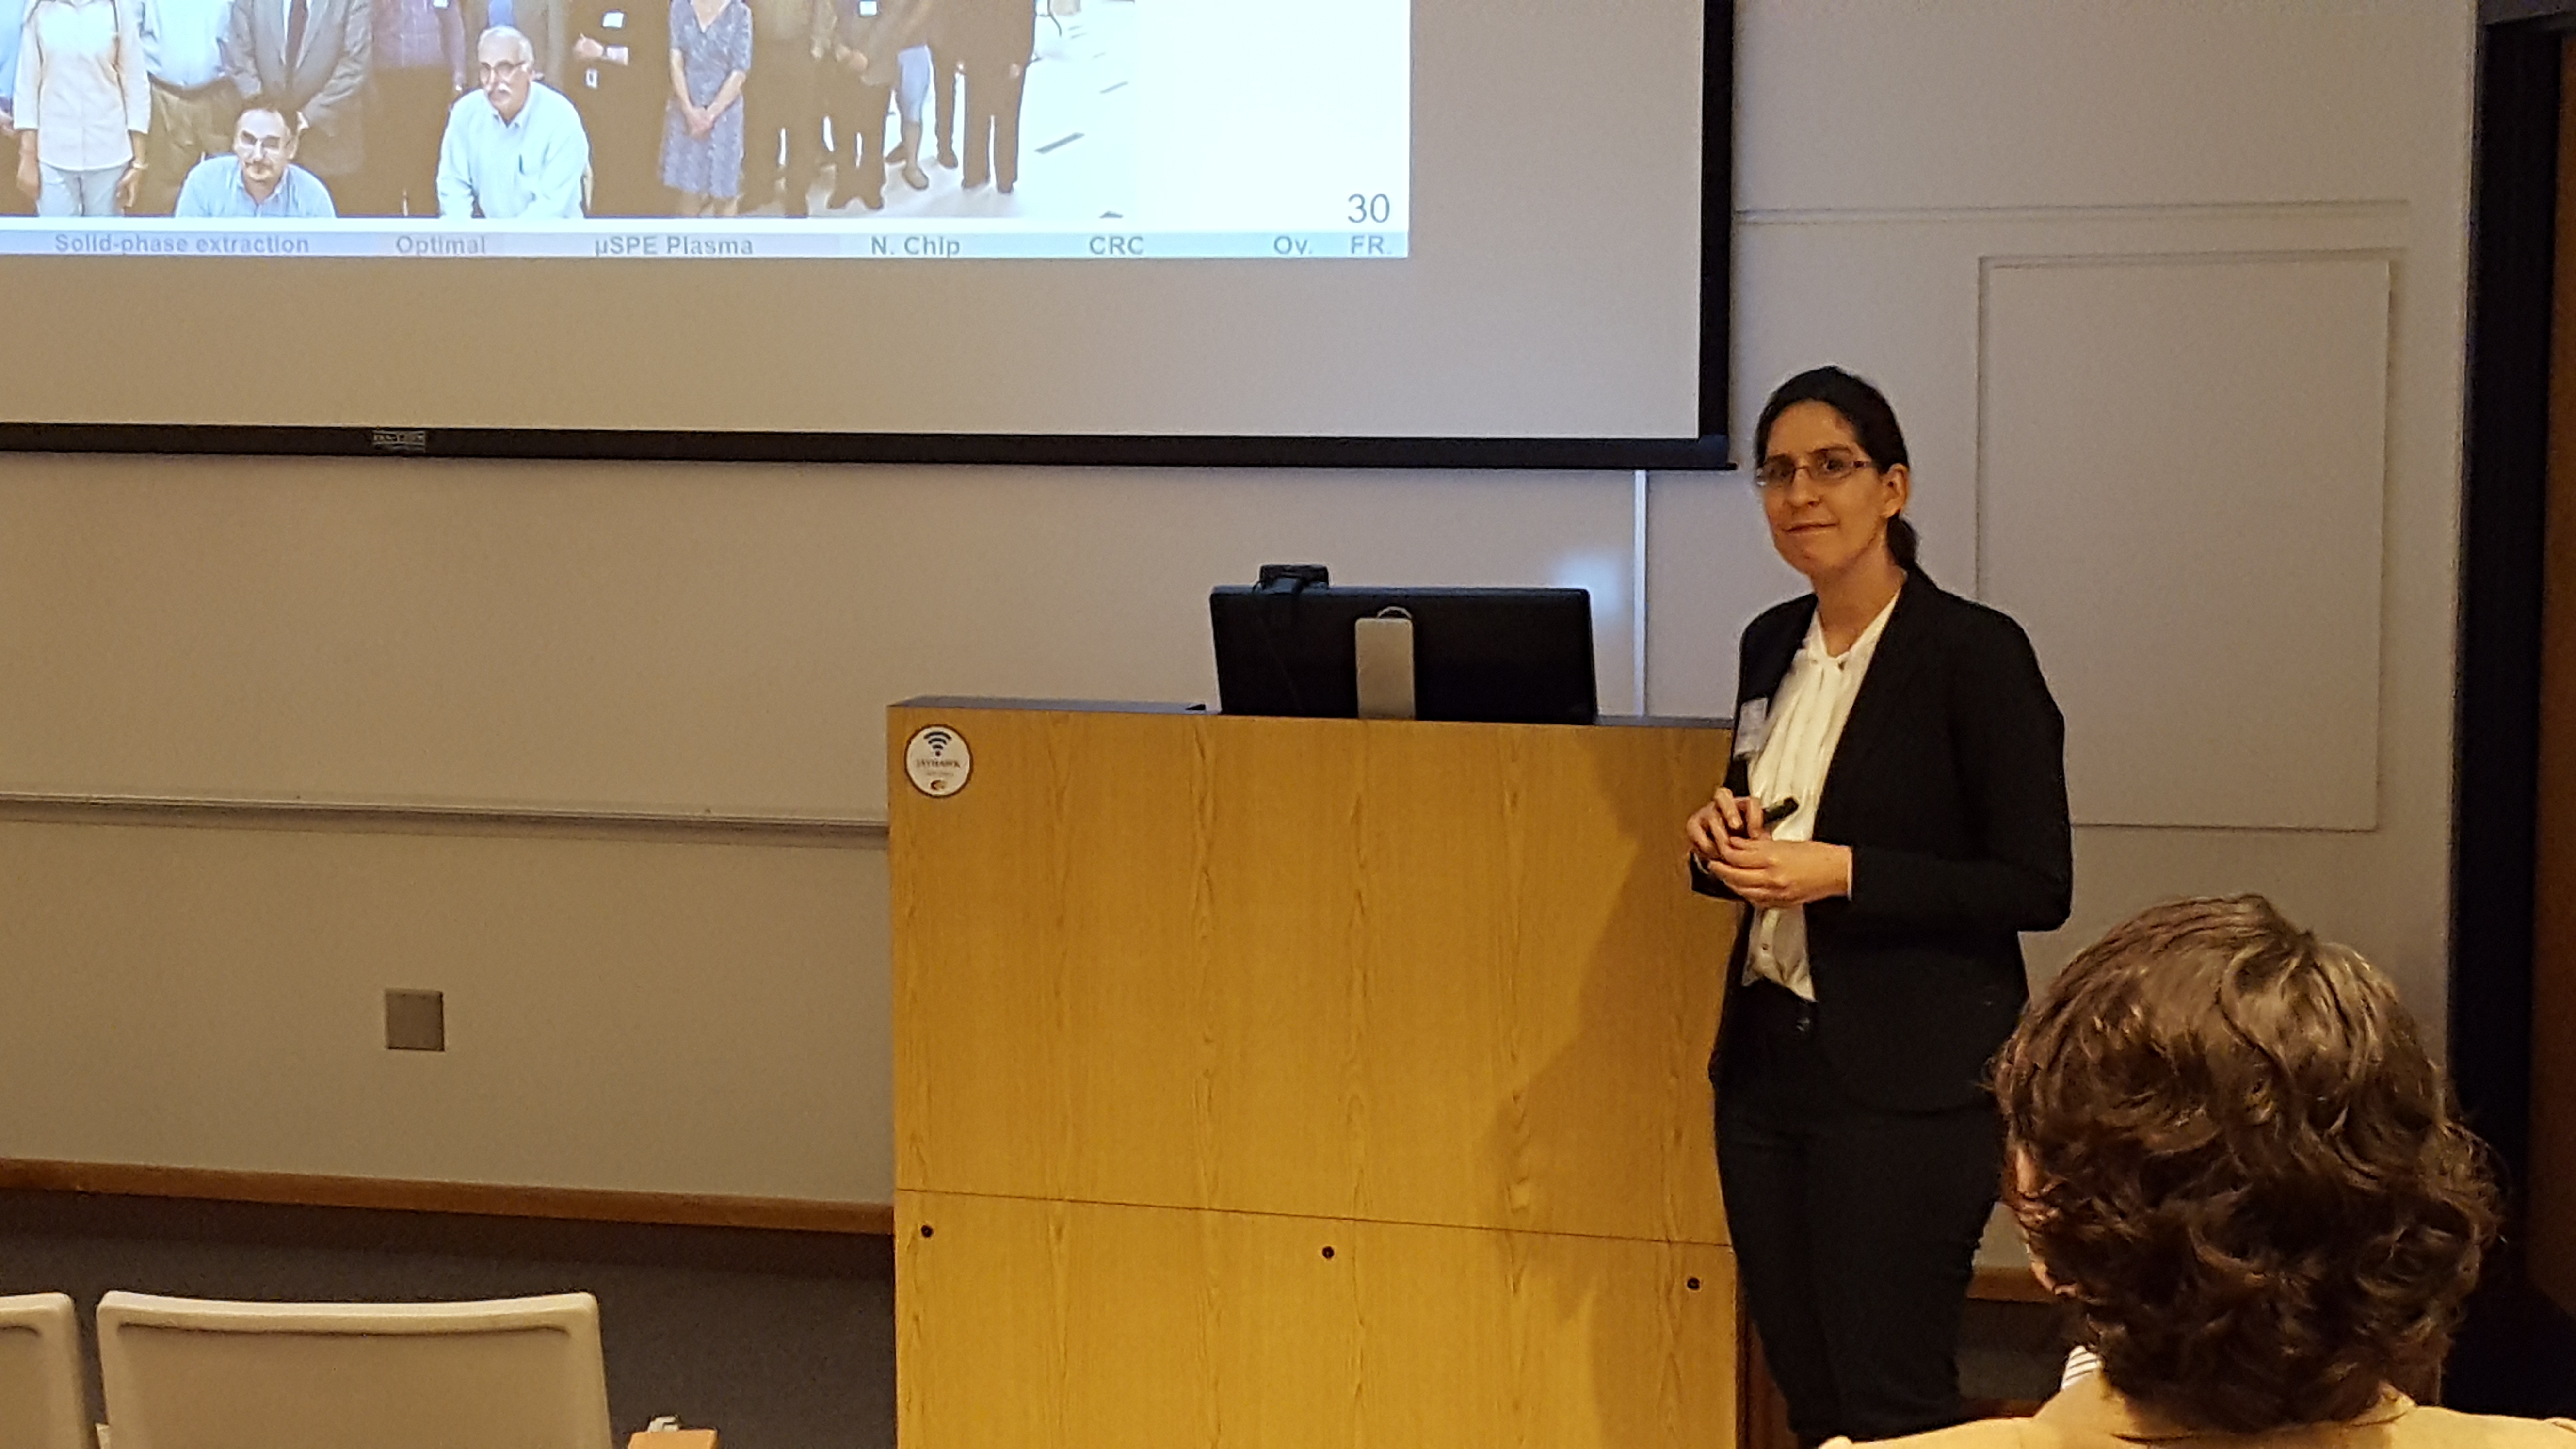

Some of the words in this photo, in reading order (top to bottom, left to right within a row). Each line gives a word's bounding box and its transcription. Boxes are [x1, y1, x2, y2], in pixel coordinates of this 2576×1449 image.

[1348, 193, 1390, 223] 30
[55, 234, 188, 253] Solid-phase
[197, 234, 309, 253] extraction
[396, 235, 485, 256] Optimal
[596, 236, 657, 256] µSPE
[667, 236, 753, 255] Plasma
[871, 236, 894, 255] N.
[905, 236, 960, 258] Chip
[1089, 236, 1144, 255] CRC
[1274, 236, 1312, 254] Ov.
